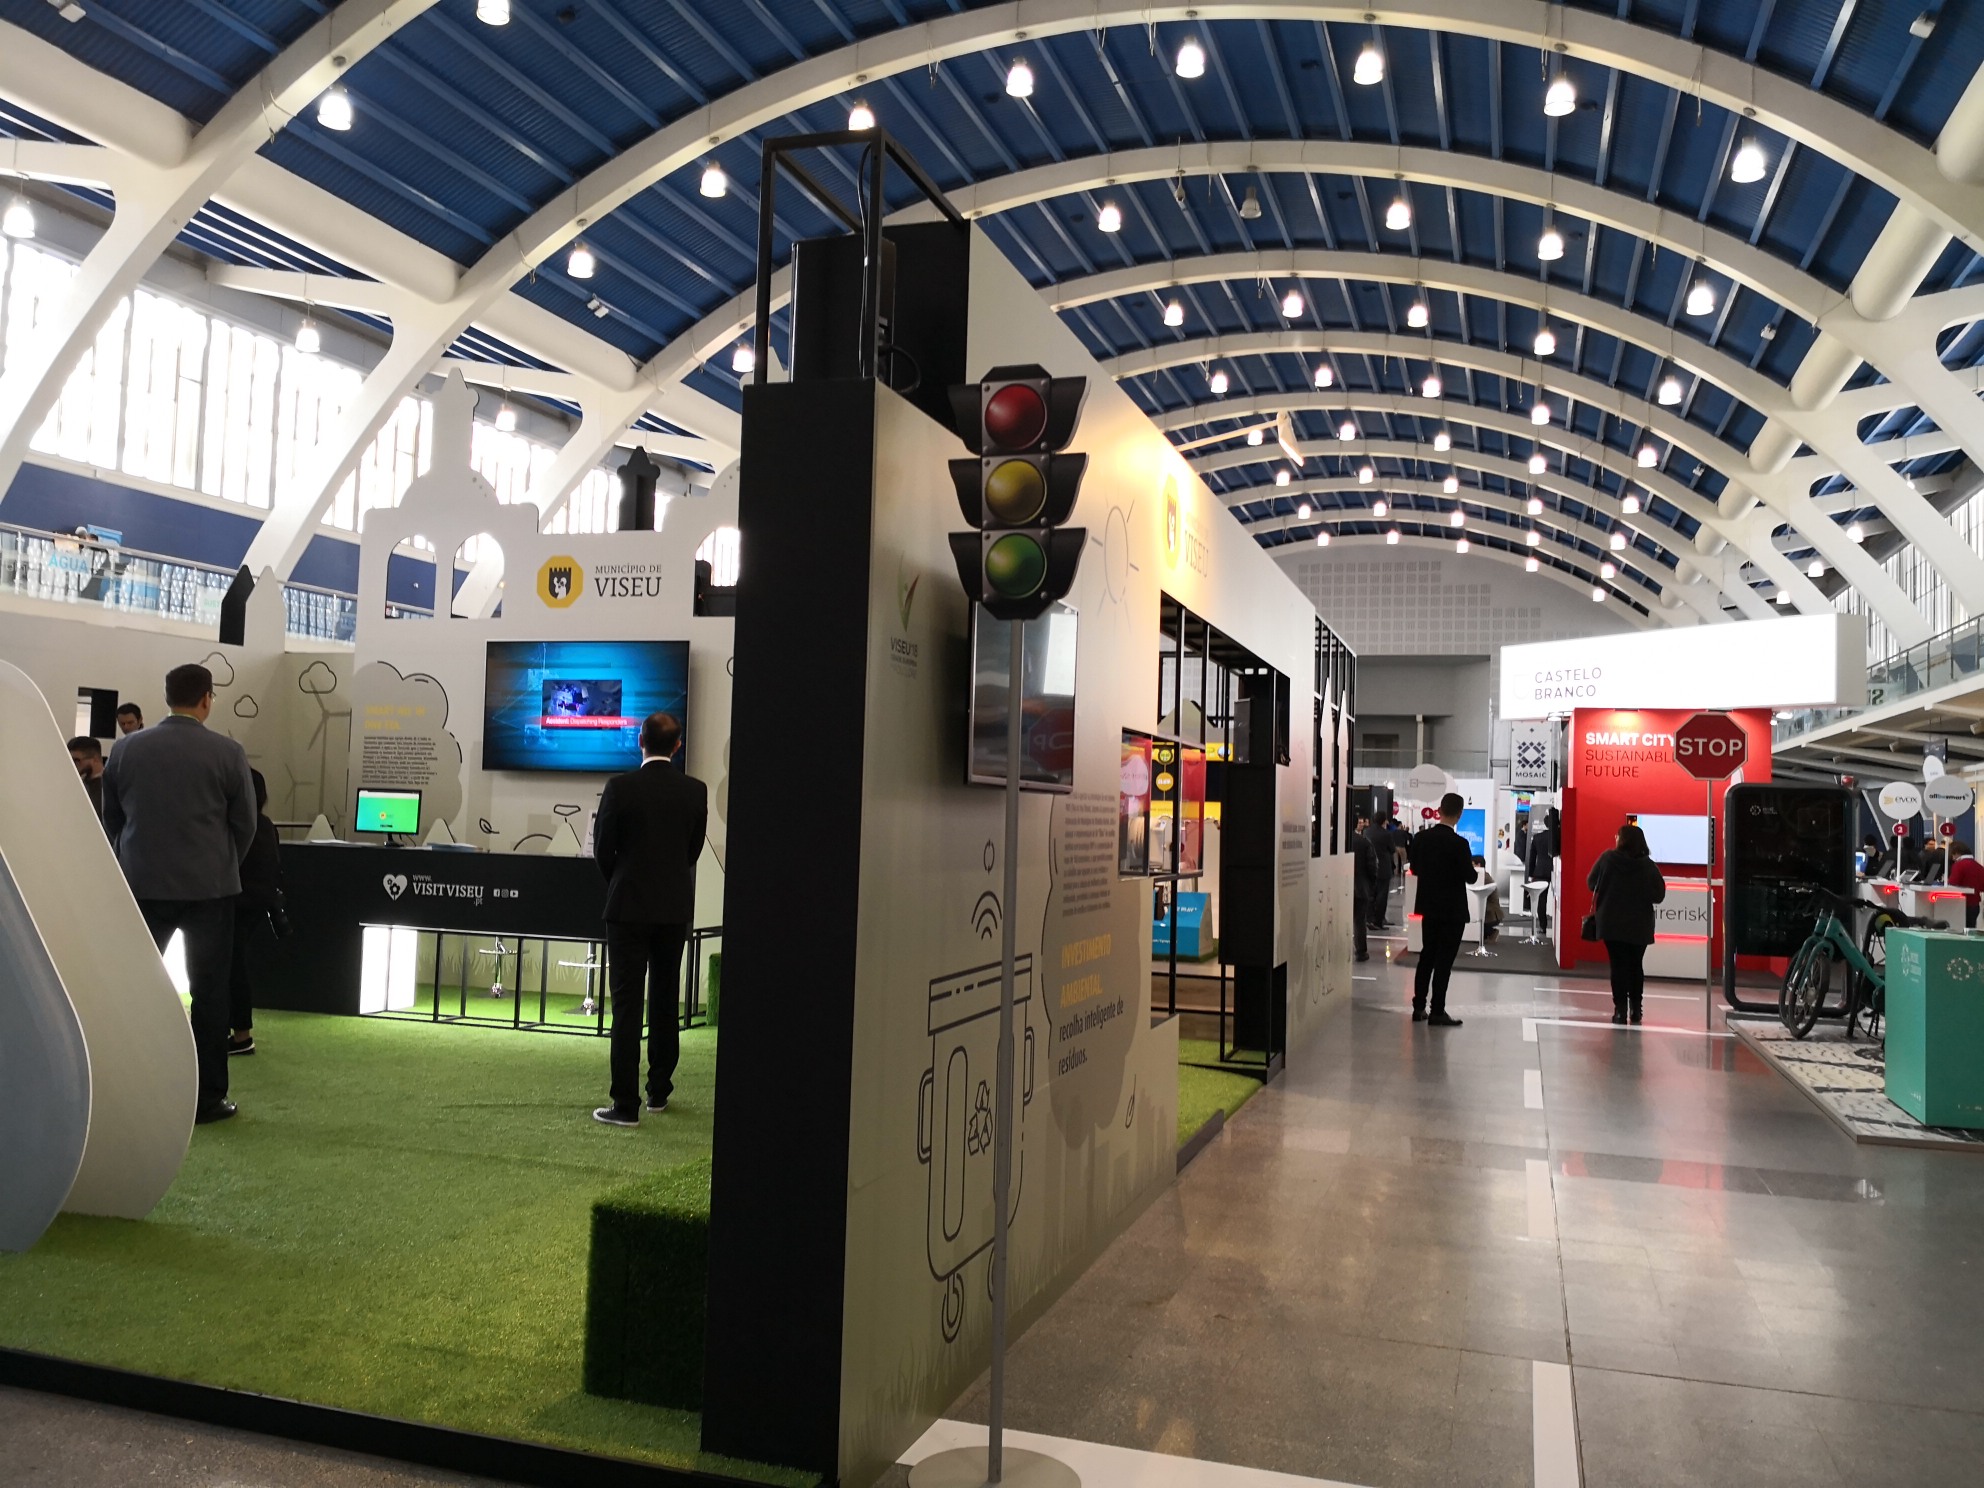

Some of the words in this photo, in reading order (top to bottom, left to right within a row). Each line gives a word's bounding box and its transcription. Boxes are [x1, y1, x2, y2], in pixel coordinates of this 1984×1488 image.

[1184, 529, 1209, 578] VISEU
[595, 562, 646, 574] MUNICÍPIO
[649, 564, 662, 574] DE
[594, 576, 662, 598] VISEU
[1535, 667, 1602, 684] CASTELO
[1534, 684, 1597, 701] BRANCO
[1585, 732, 1640, 746] SMART
[1641, 732, 1675, 748] CITY
[1678, 737, 1743, 757] STOP
[1585, 764, 1640, 779] FUTURE
[1654, 905, 1708, 922] irerisk
[1059, 1013, 1084, 1042] recolha
[1084, 1004, 1116, 1029] inteligente
[1116, 995, 1124, 1015] de
[1058, 1047, 1088, 1076] resíduos.
